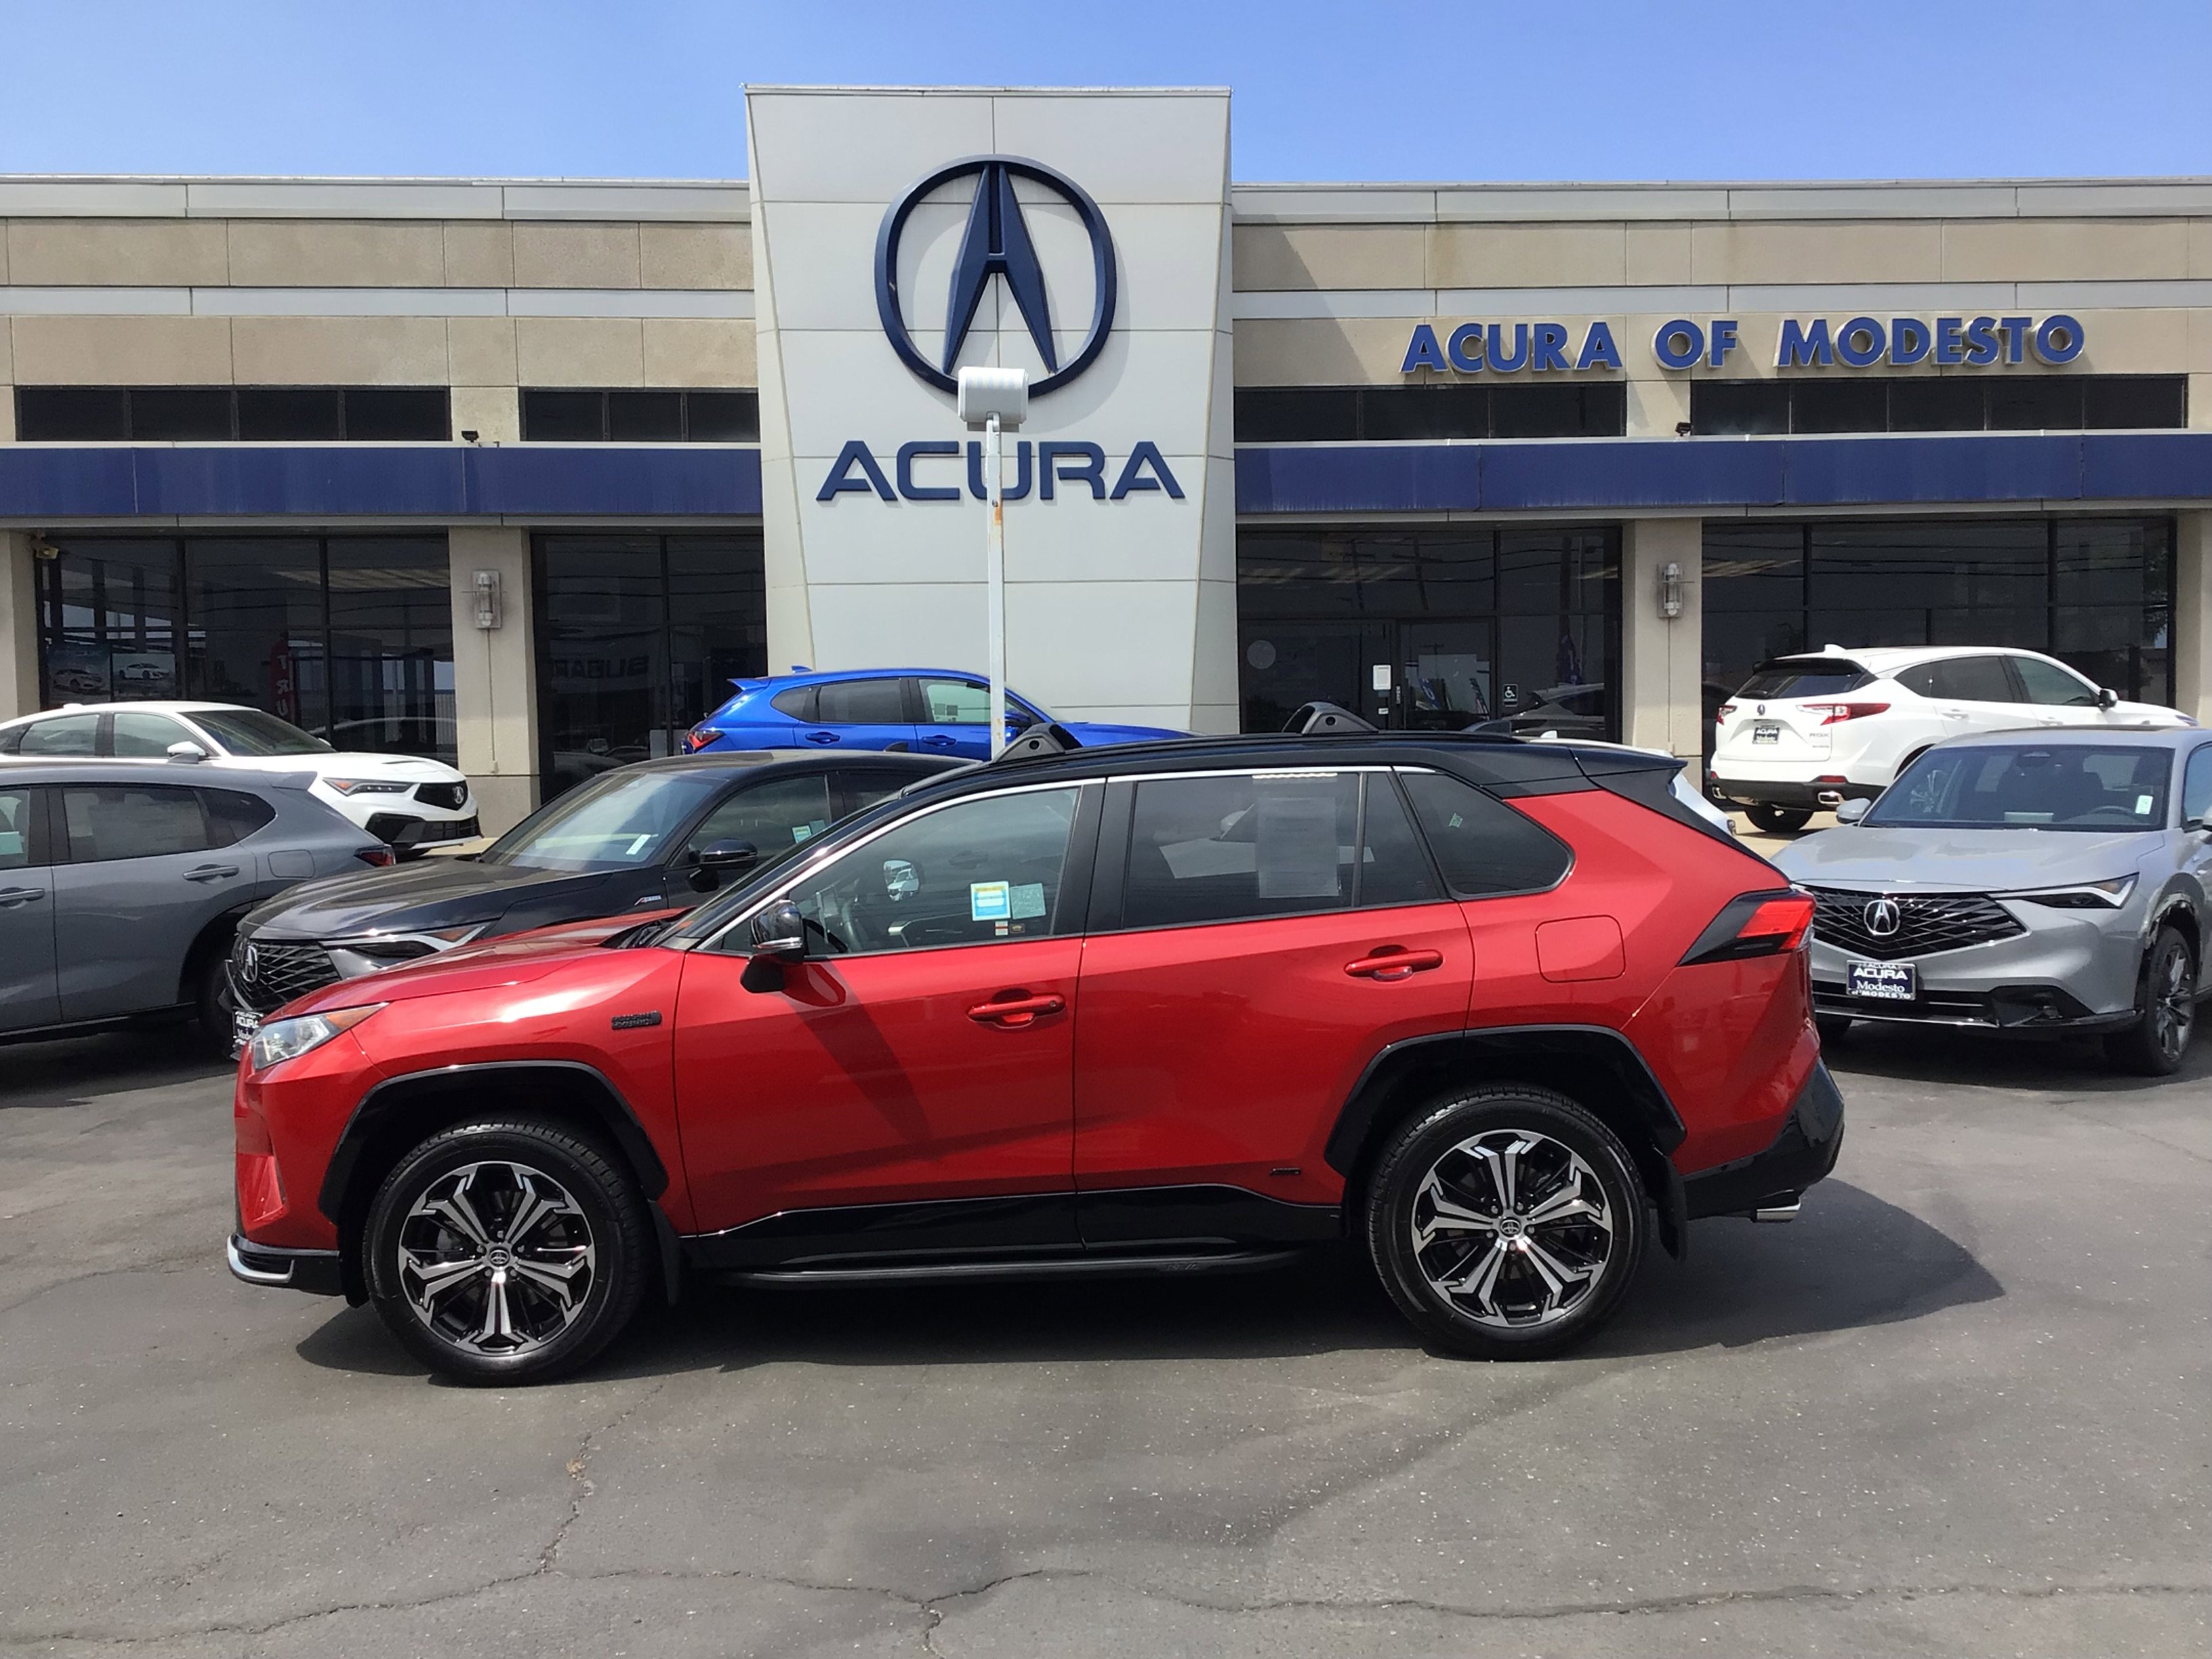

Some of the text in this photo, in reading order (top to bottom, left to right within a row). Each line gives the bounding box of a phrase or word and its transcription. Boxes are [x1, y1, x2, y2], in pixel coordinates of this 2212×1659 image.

[1399, 314, 2085, 375] ACURA OF MODESTO
[815, 441, 1186, 501] ACURA
[1853, 967, 1908, 980] ACURA
[1856, 979, 1906, 994] Modesto
[1861, 990, 1911, 1000] MODESTO
